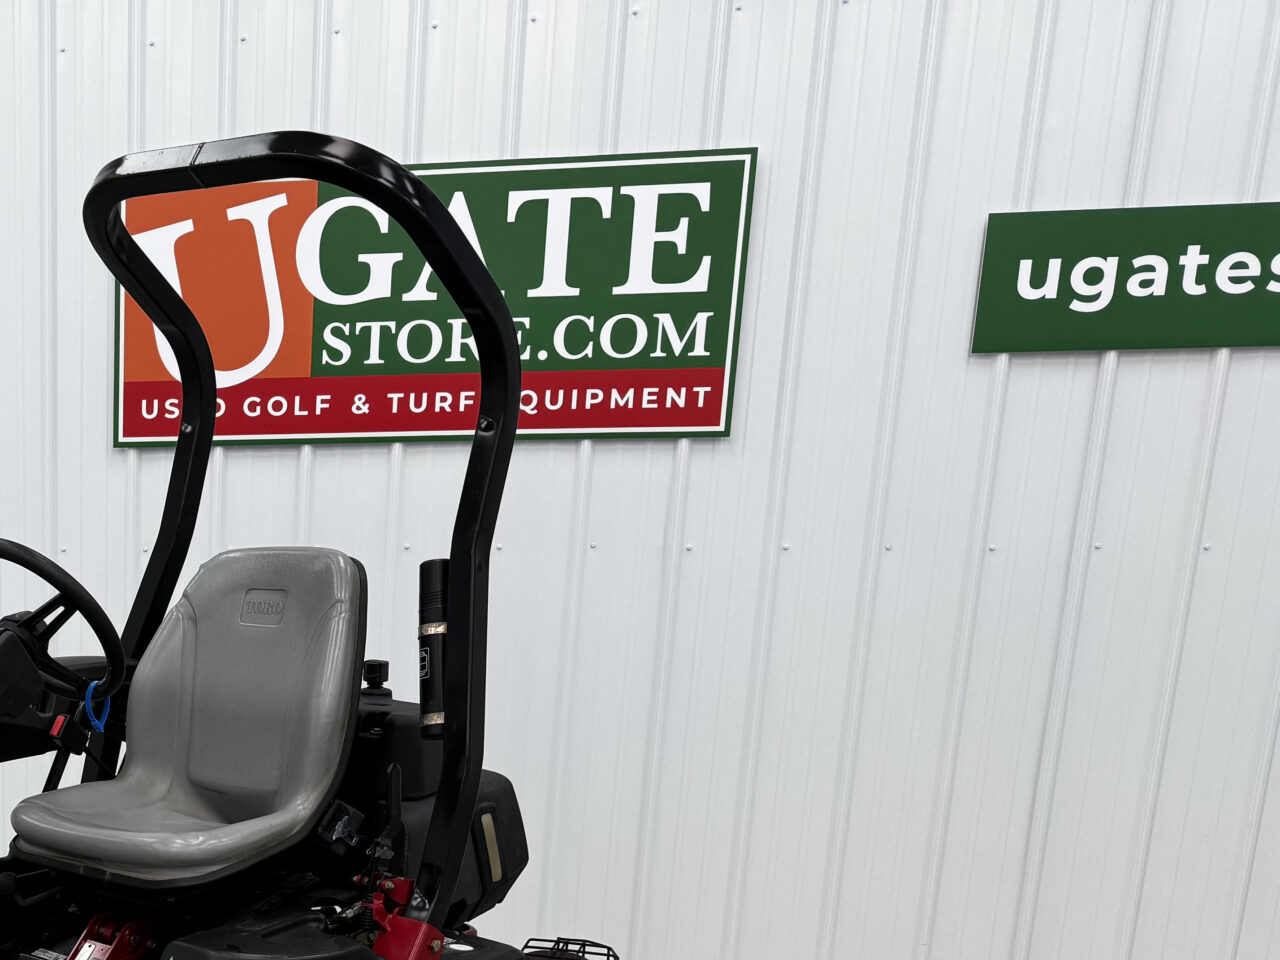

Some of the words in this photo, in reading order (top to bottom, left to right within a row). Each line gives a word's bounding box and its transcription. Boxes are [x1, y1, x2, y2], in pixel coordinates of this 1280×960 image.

[141, 397, 226, 420] USD
[243, 395, 331, 417] GOLF
[351, 393, 370, 414] &
[387, 391, 475, 413] TURF
[519, 387, 712, 415] QUIPMENT
